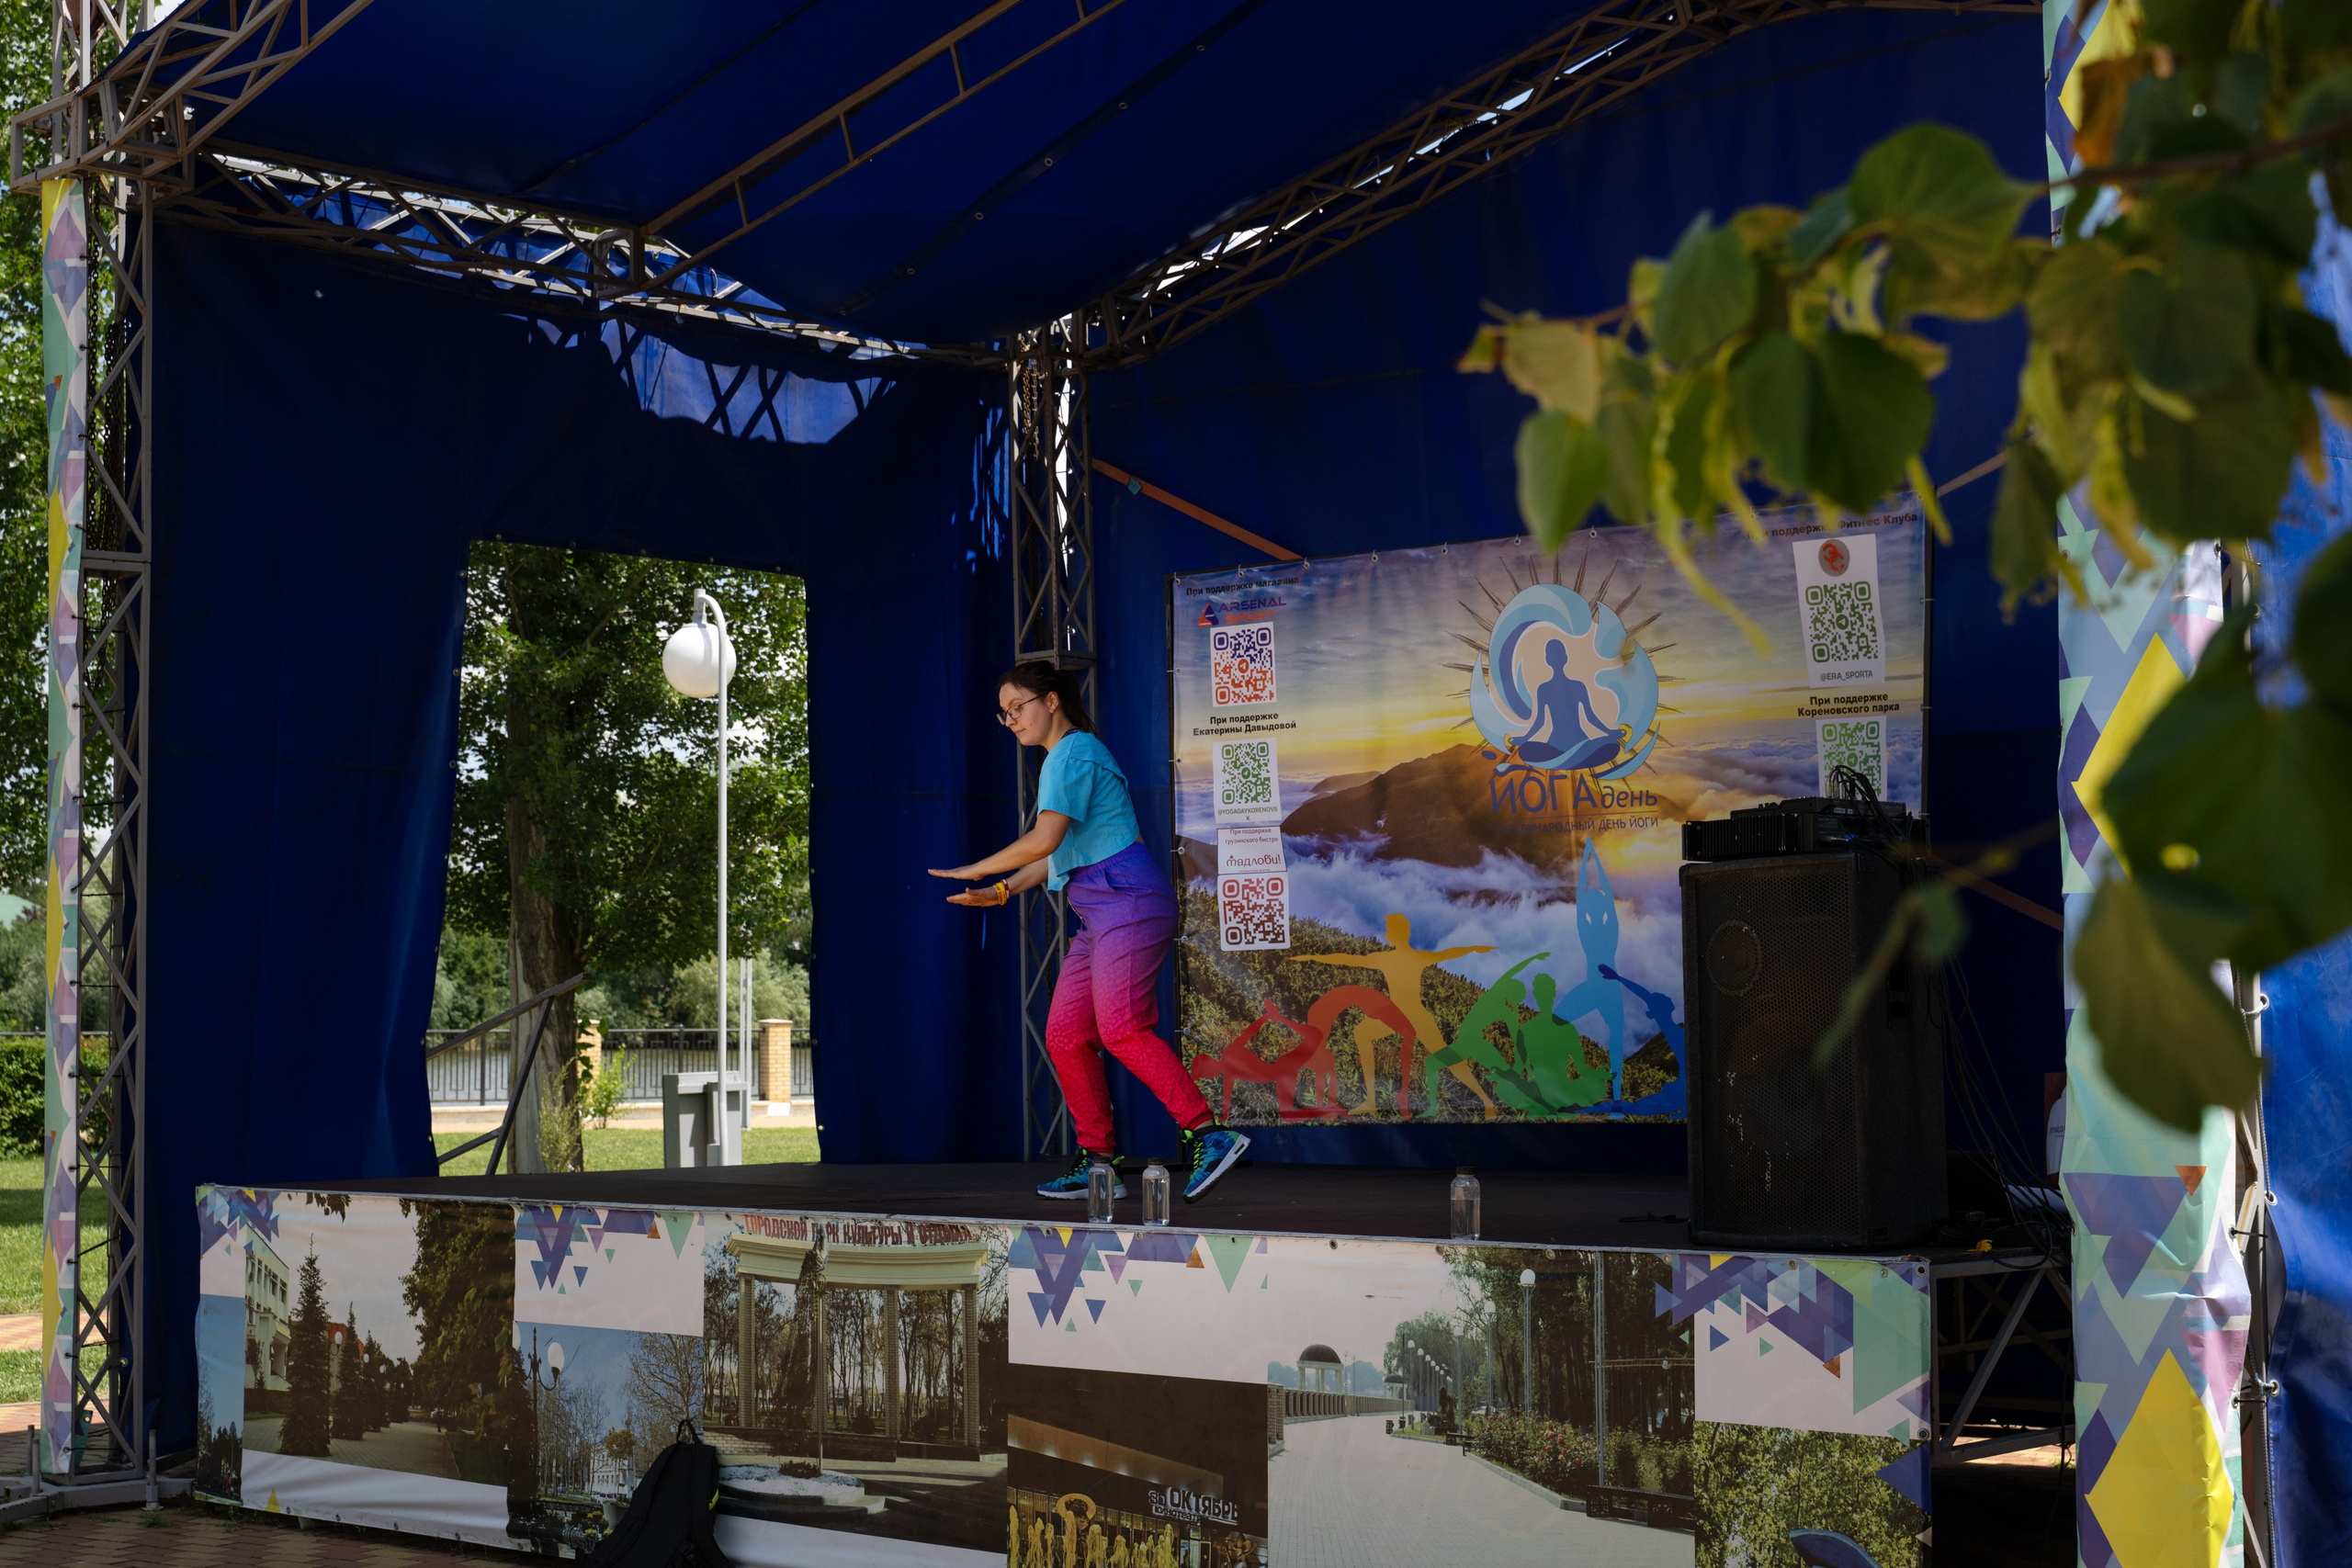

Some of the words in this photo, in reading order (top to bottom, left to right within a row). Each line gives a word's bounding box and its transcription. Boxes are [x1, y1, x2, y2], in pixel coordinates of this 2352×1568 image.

[1838, 517, 1880, 530] Фитнес
[1883, 513, 1918, 525] Клуба
[1186, 587, 1204, 598] При
[1205, 582, 1253, 594] поддержке
[1256, 577, 1300, 589] магазина
[1218, 597, 1287, 614] ARSENAL
[1226, 610, 1276, 626] SPORT
[1820, 670, 1873, 682] @ERA_SPORTA
[1810, 695, 1831, 706] При
[1834, 693, 1889, 705] поддержке
[1798, 704, 1871, 717] Кореновского
[1872, 702, 1900, 715] парка
[1210, 716, 1227, 726] При
[1229, 712, 1279, 724] поддержке
[1193, 726, 1242, 737] Екатерины
[1244, 720, 1296, 734] Давыдовой
[1489, 762, 1598, 815] ЙОГА
[1601, 785, 1658, 809] день
[1599, 818, 1626, 832] ДЕНЬ
[1630, 815, 1659, 829] ЙОГИ
[743, 1213, 808, 1241] ГОРОДСКОЙ
[842, 1223, 902, 1246] КУЛЬТУРЫ
[1169, 1486, 1239, 1520] ОКТЯБРЬ
